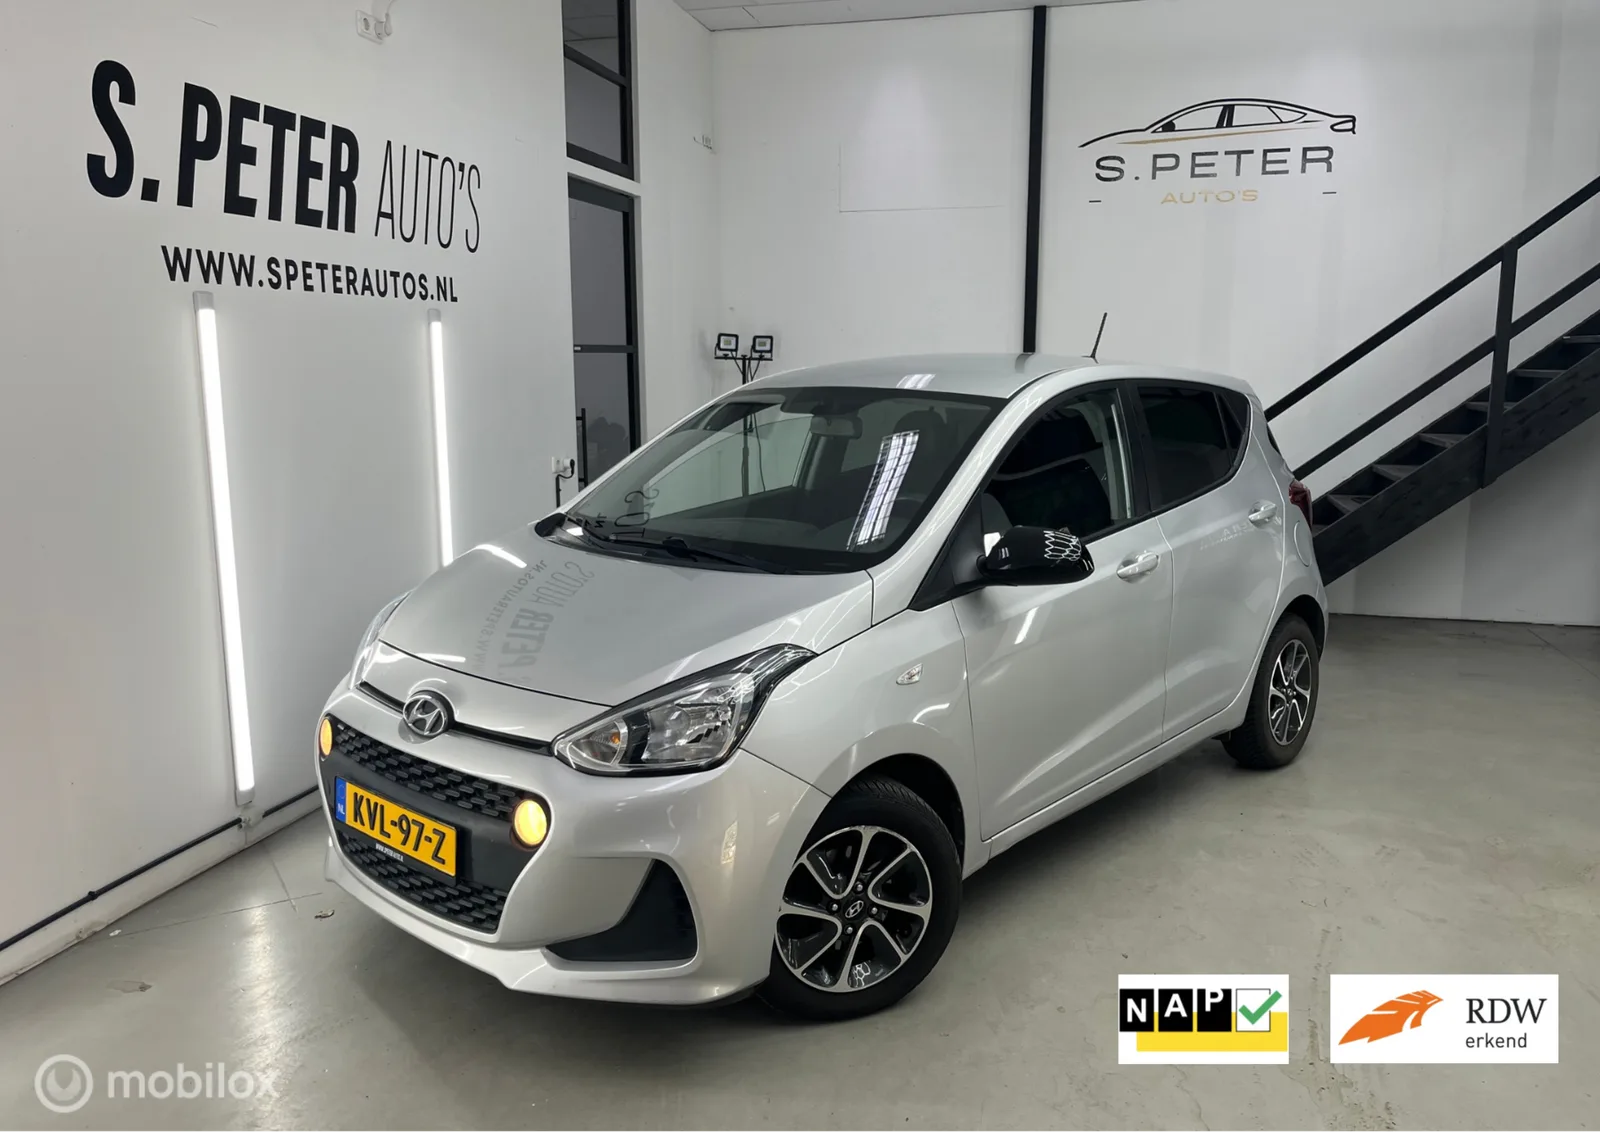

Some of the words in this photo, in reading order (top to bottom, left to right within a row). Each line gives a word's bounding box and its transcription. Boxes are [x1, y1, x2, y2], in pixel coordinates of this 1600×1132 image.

[86, 59, 160, 202] S.
[176, 82, 360, 234] PETER
[374, 139, 481, 253] AUTO'S
[1160, 189, 1259, 205] AUTO'S
[161, 244, 459, 303] WWW.SPETERAUTOS.NL
[337, 803, 346, 815] NL
[352, 791, 447, 866] KVL-97-Z
